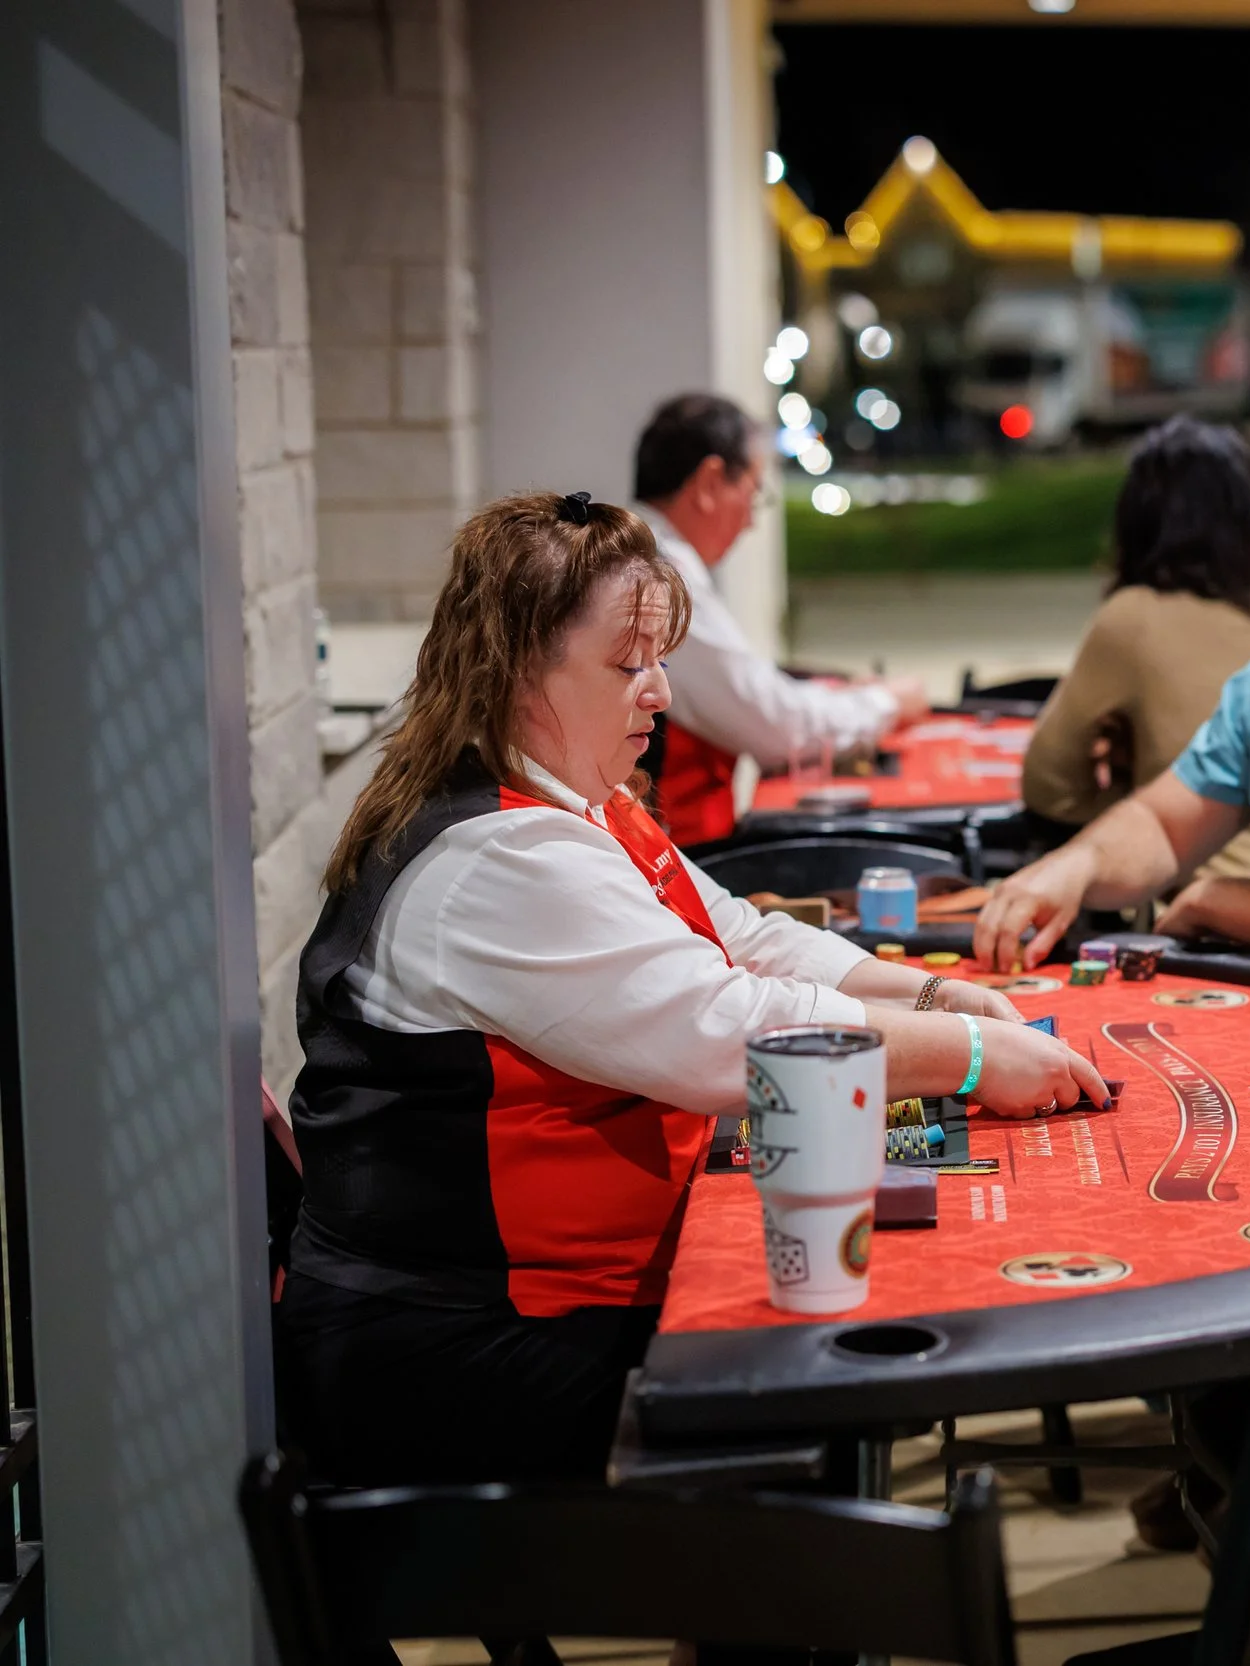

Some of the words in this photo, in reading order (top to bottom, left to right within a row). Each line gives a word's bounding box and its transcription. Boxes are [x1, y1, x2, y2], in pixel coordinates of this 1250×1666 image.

[1160, 1053, 1195, 1076] PAYS
[1175, 1078, 1226, 1130] INSURANCE
[1068, 1118, 1092, 1137] DRAW
[1072, 1138, 1096, 1156] MUST
[1193, 1138, 1221, 1150] TO
[1077, 1156, 1102, 1185] DEALER
[1174, 1158, 1212, 1179] PAYS
